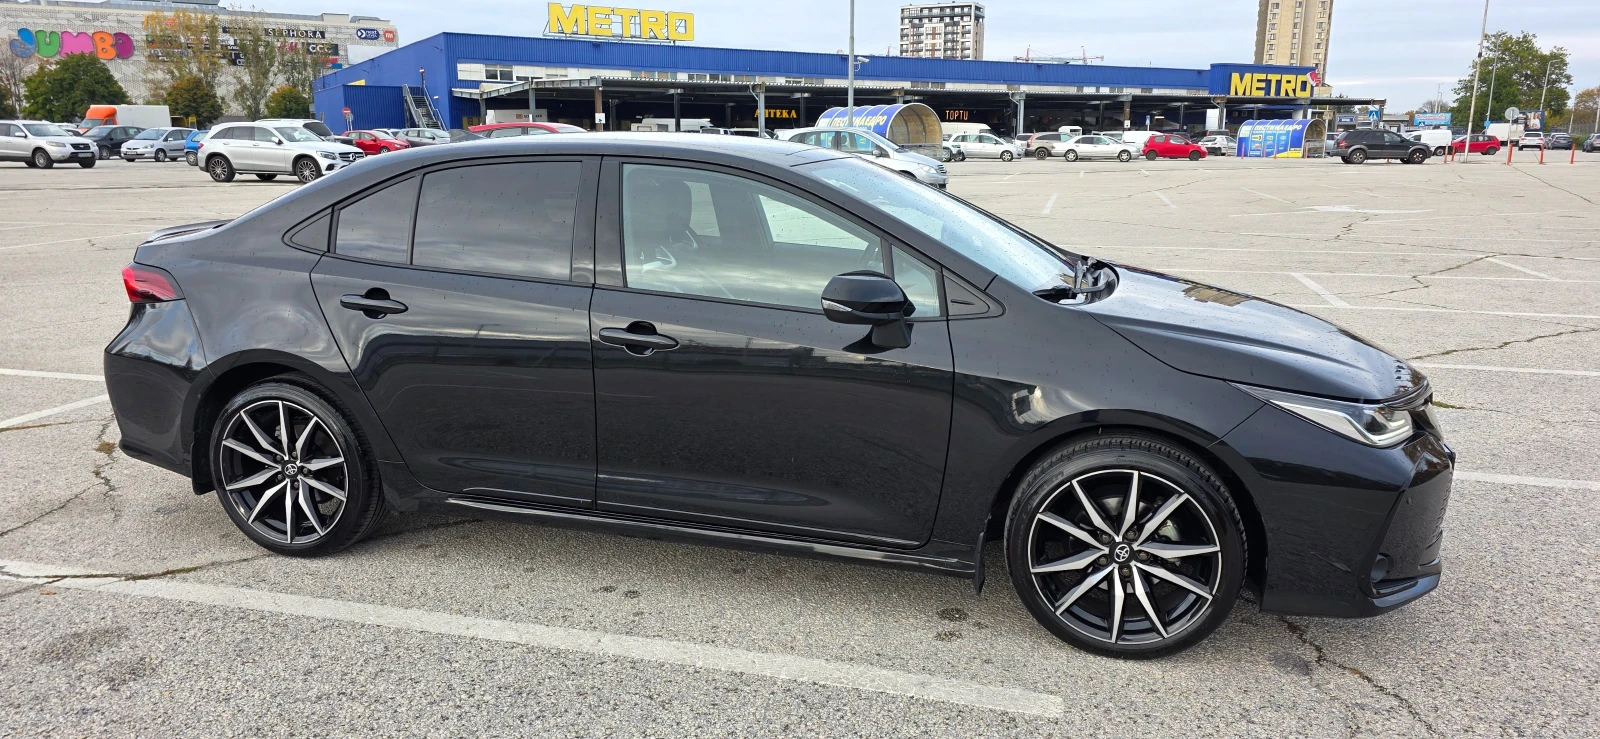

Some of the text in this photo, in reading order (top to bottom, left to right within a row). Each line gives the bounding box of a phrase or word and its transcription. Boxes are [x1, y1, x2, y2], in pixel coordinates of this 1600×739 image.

[268, 28, 322, 39] SEPHORA
[548, 2, 694, 41] METRO
[9, 27, 135, 60] JUMBO
[1230, 72, 1311, 98] METRO
